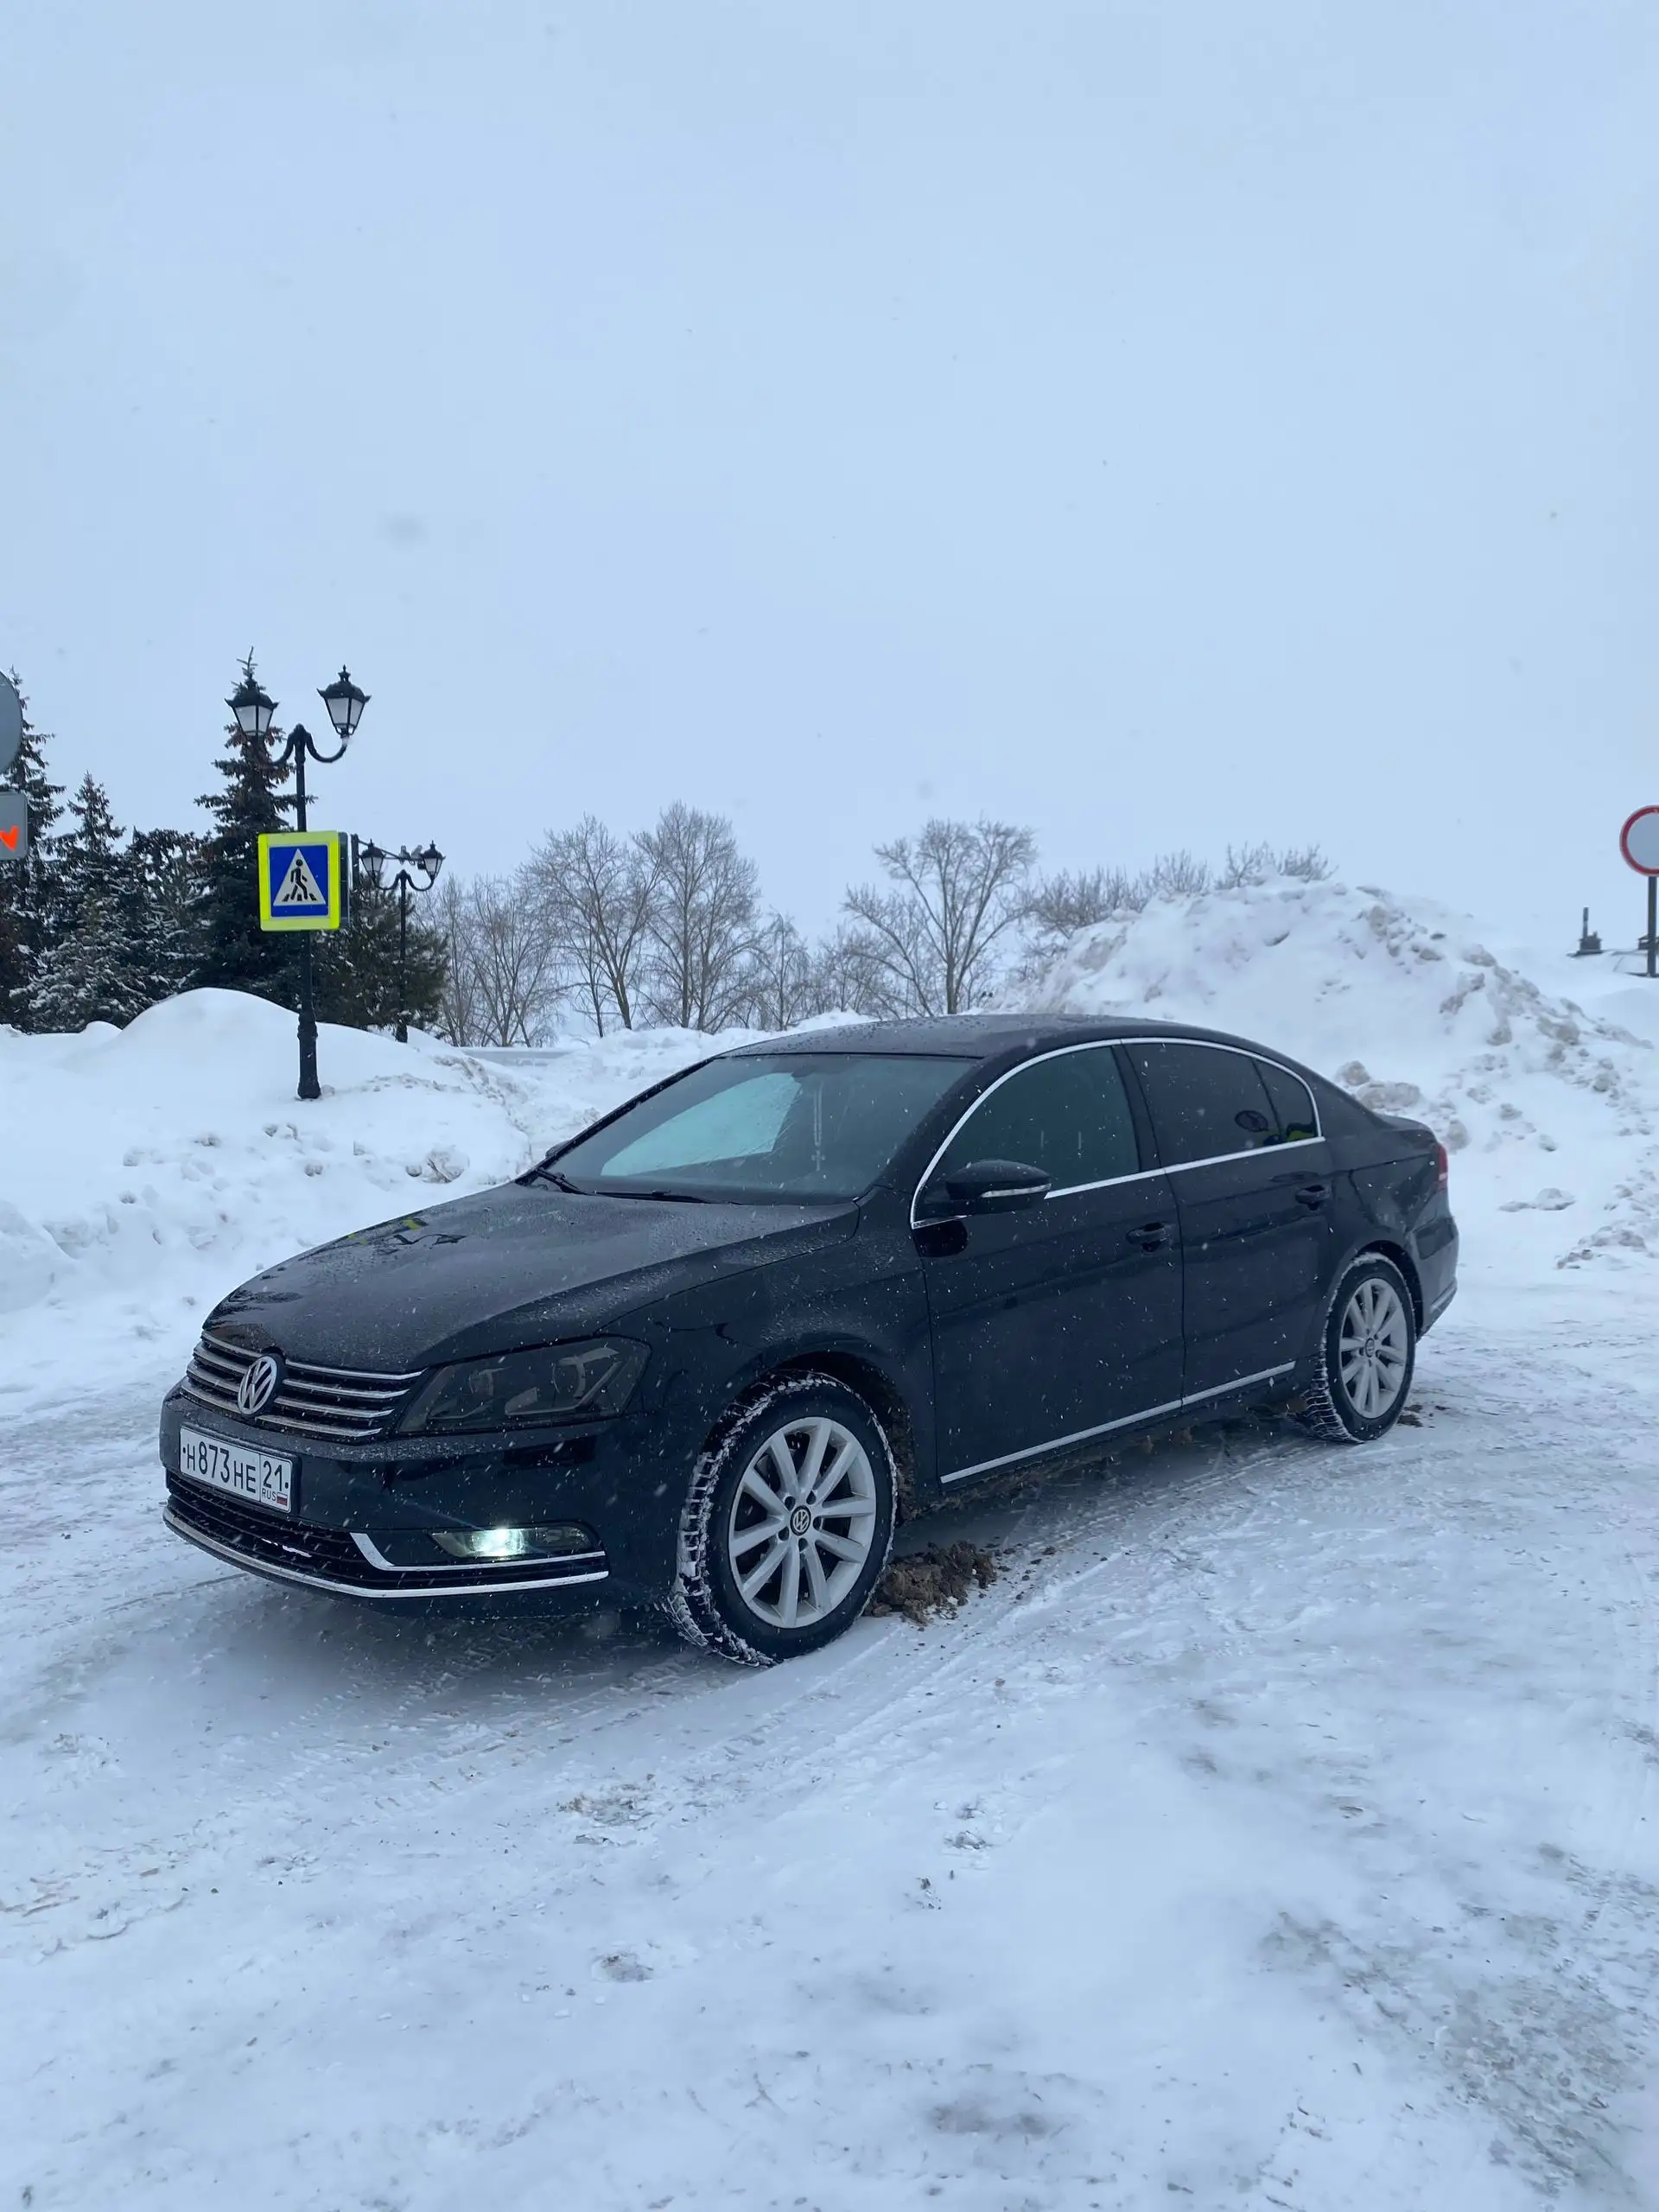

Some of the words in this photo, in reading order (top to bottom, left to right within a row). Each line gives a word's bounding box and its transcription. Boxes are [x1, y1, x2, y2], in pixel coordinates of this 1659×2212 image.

[238, 1356, 277, 1414] VW
[263, 1460, 283, 1492] 21
[261, 1488, 276, 1502] RUS
